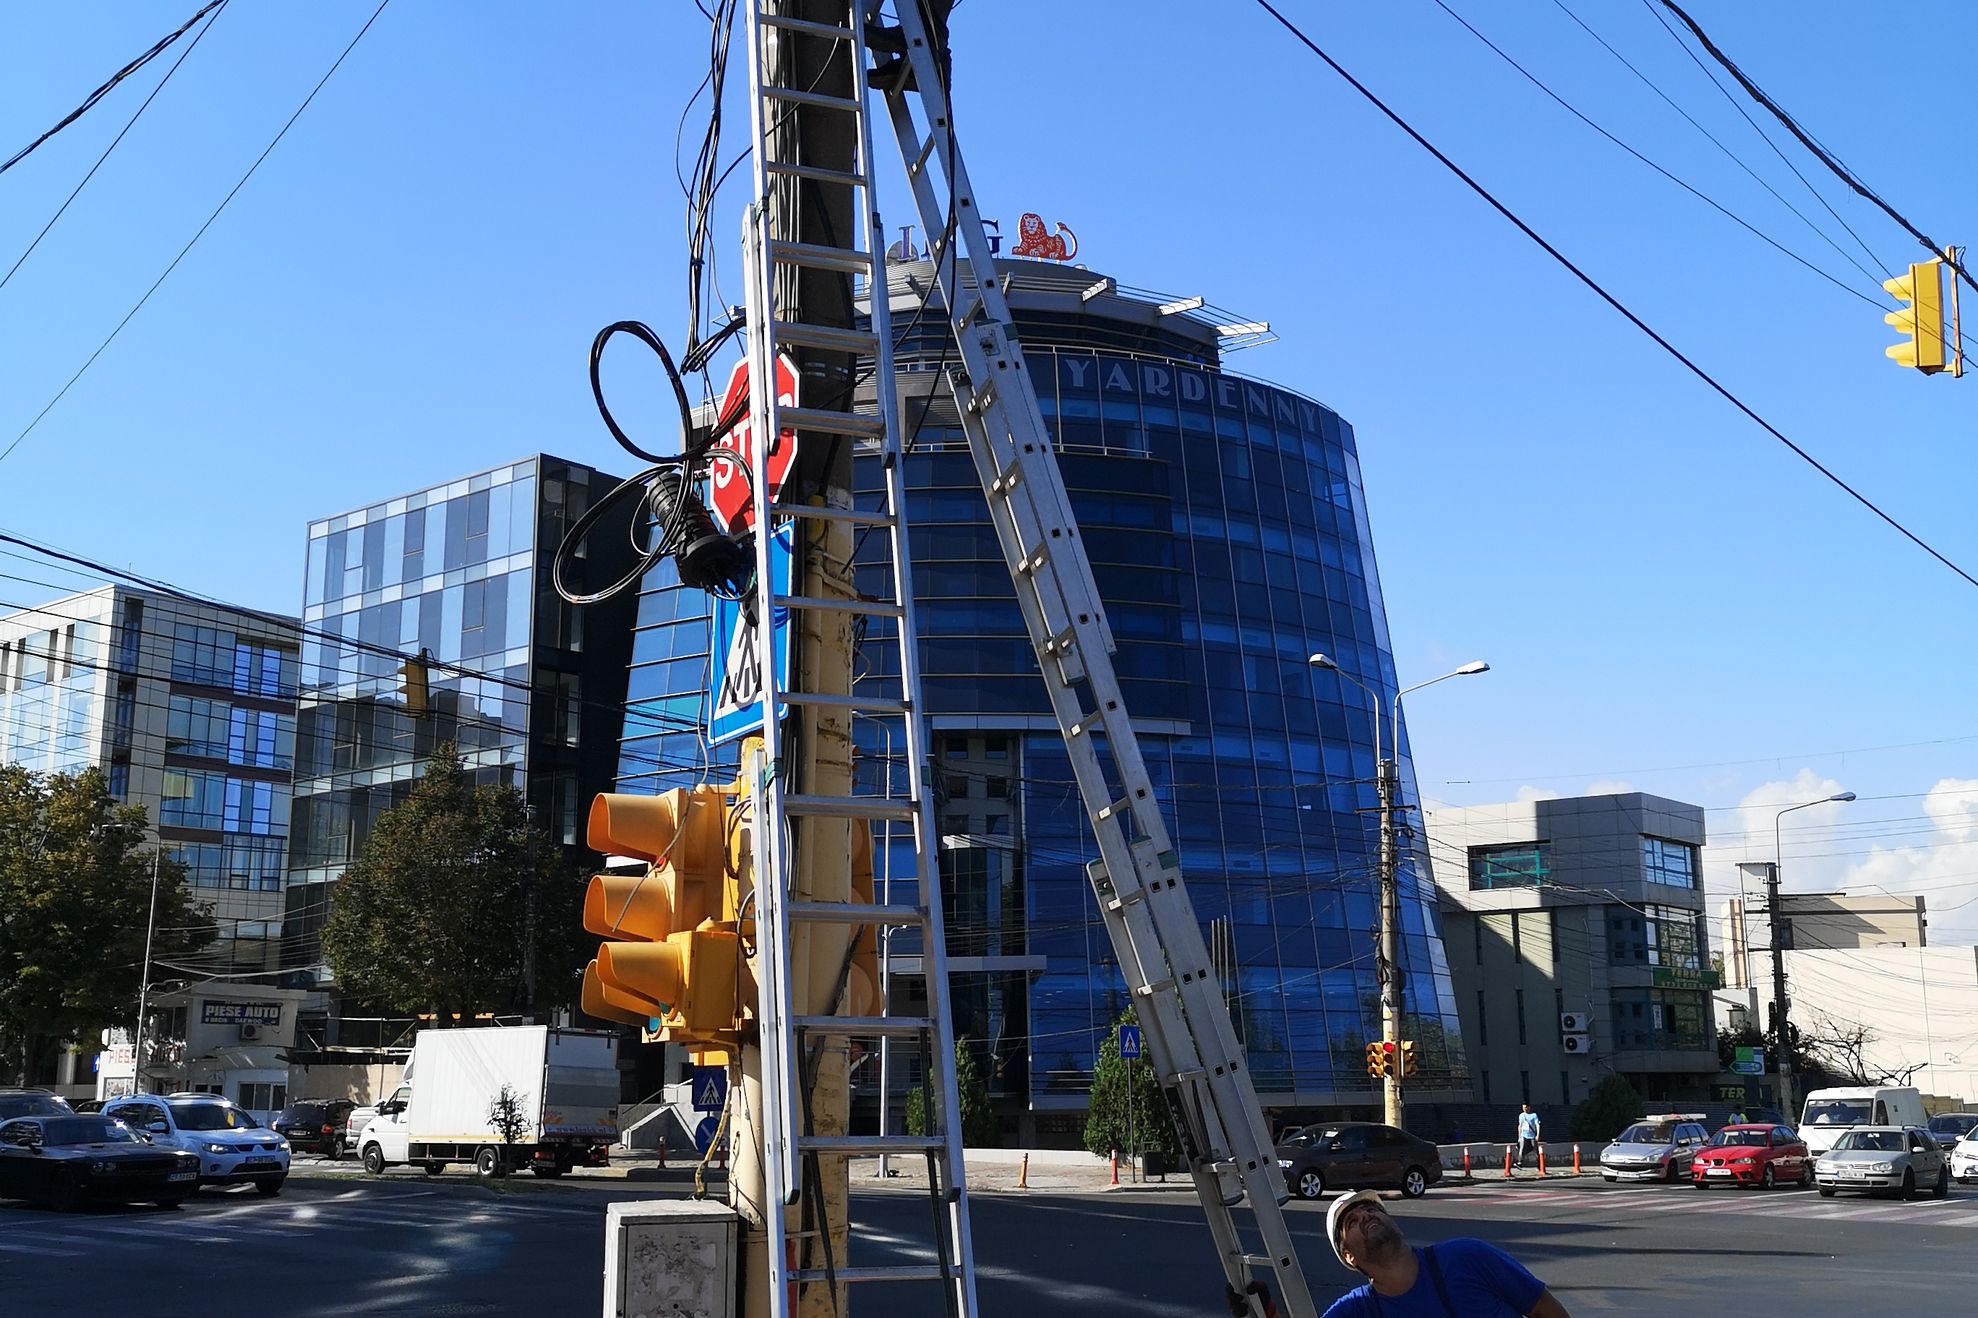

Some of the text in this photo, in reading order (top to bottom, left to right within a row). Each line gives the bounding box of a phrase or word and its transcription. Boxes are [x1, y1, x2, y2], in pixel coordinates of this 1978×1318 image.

[897, 219, 1004, 262] IG
[1064, 358, 1317, 432] YARDENNY
[715, 392, 793, 490] ST
[205, 1004, 279, 1018] PIESE AUTO
[108, 1048, 136, 1064] PIES
